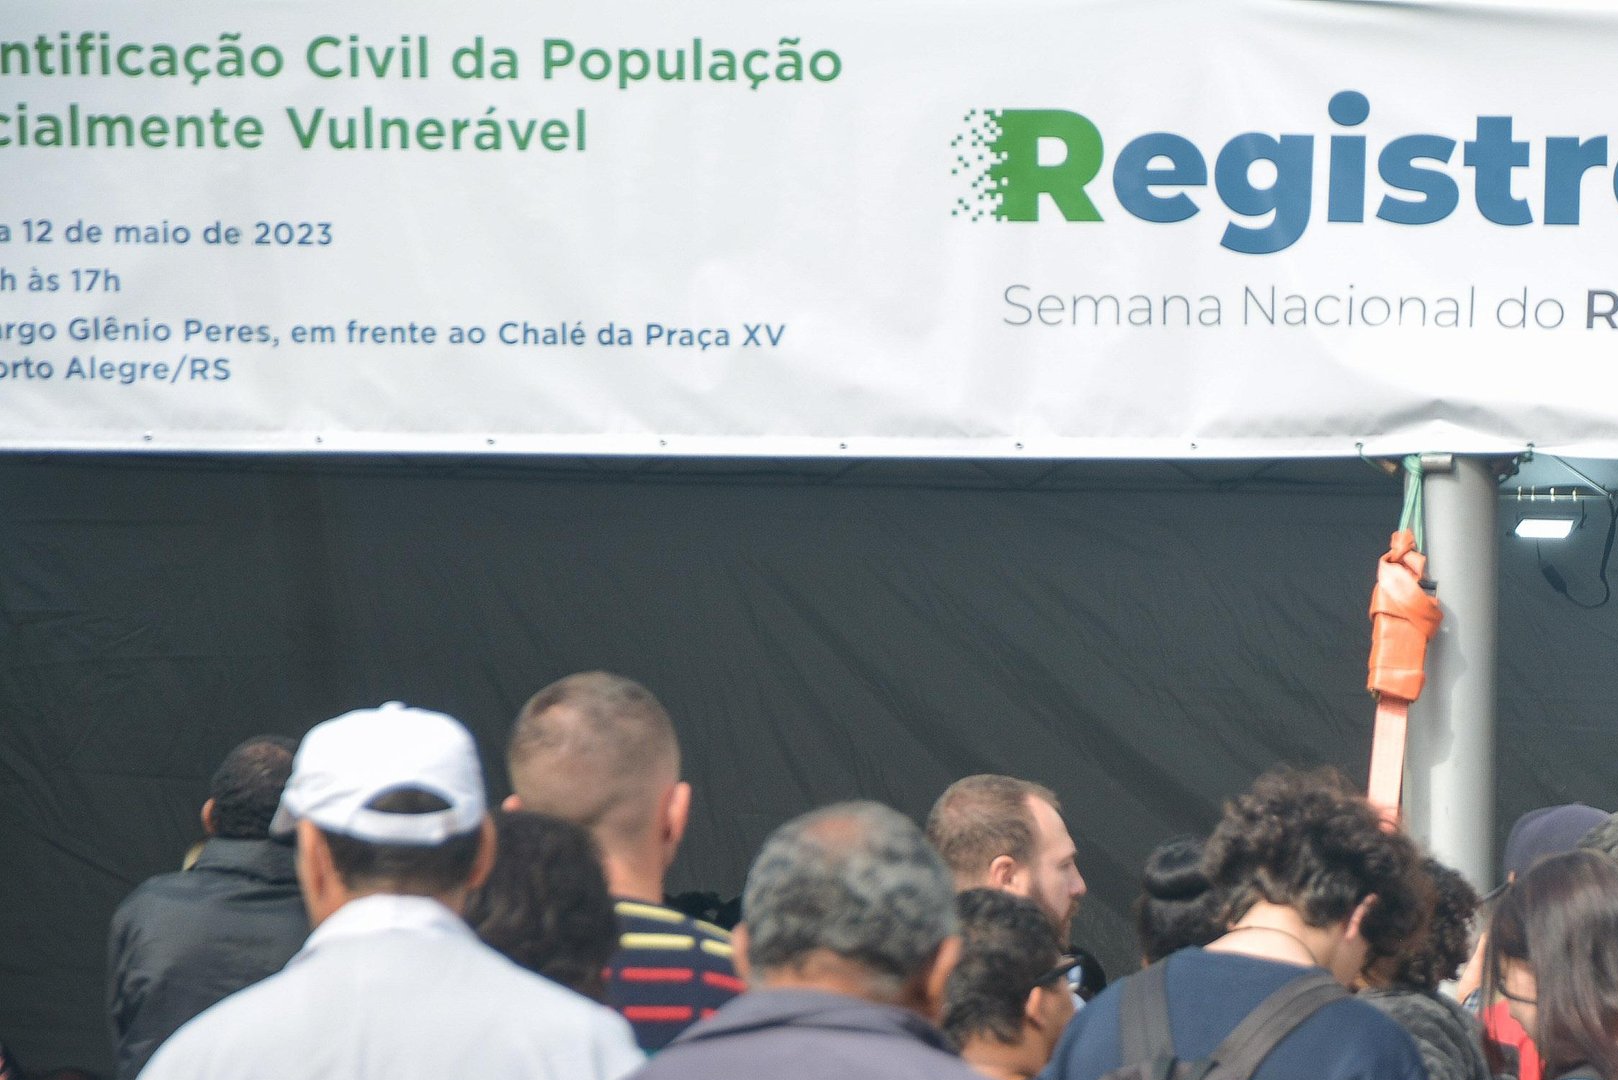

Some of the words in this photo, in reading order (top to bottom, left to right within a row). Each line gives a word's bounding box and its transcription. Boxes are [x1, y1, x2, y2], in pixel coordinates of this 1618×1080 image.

[0, 31, 283, 85] ntificação
[306, 35, 428, 79] Civil
[452, 36, 518, 79] da
[544, 38, 841, 90] População
[286, 107, 585, 151] Vulnerável
[23, 220, 52, 243] 12
[65, 220, 102, 243] de
[115, 221, 190, 244] maio
[203, 222, 240, 245] de
[255, 222, 332, 245] 2023
[28, 267, 59, 292] às
[72, 269, 120, 291] 17h
[1004, 285, 1220, 325] Semana
[1245, 285, 1474, 327] Nacional
[1497, 287, 1564, 328] do
[0, 323, 56, 345] rgo
[69, 317, 170, 341] Glênio
[185, 319, 279, 346] Peres,
[291, 326, 335, 343] em
[347, 321, 436, 343] frente
[449, 327, 485, 344] ao
[499, 322, 586, 345] Chalé
[597, 323, 632, 346] da
[647, 324, 729, 350] Praça
[743, 325, 785, 347] XV
[65, 356, 230, 384] Alegre/RS
